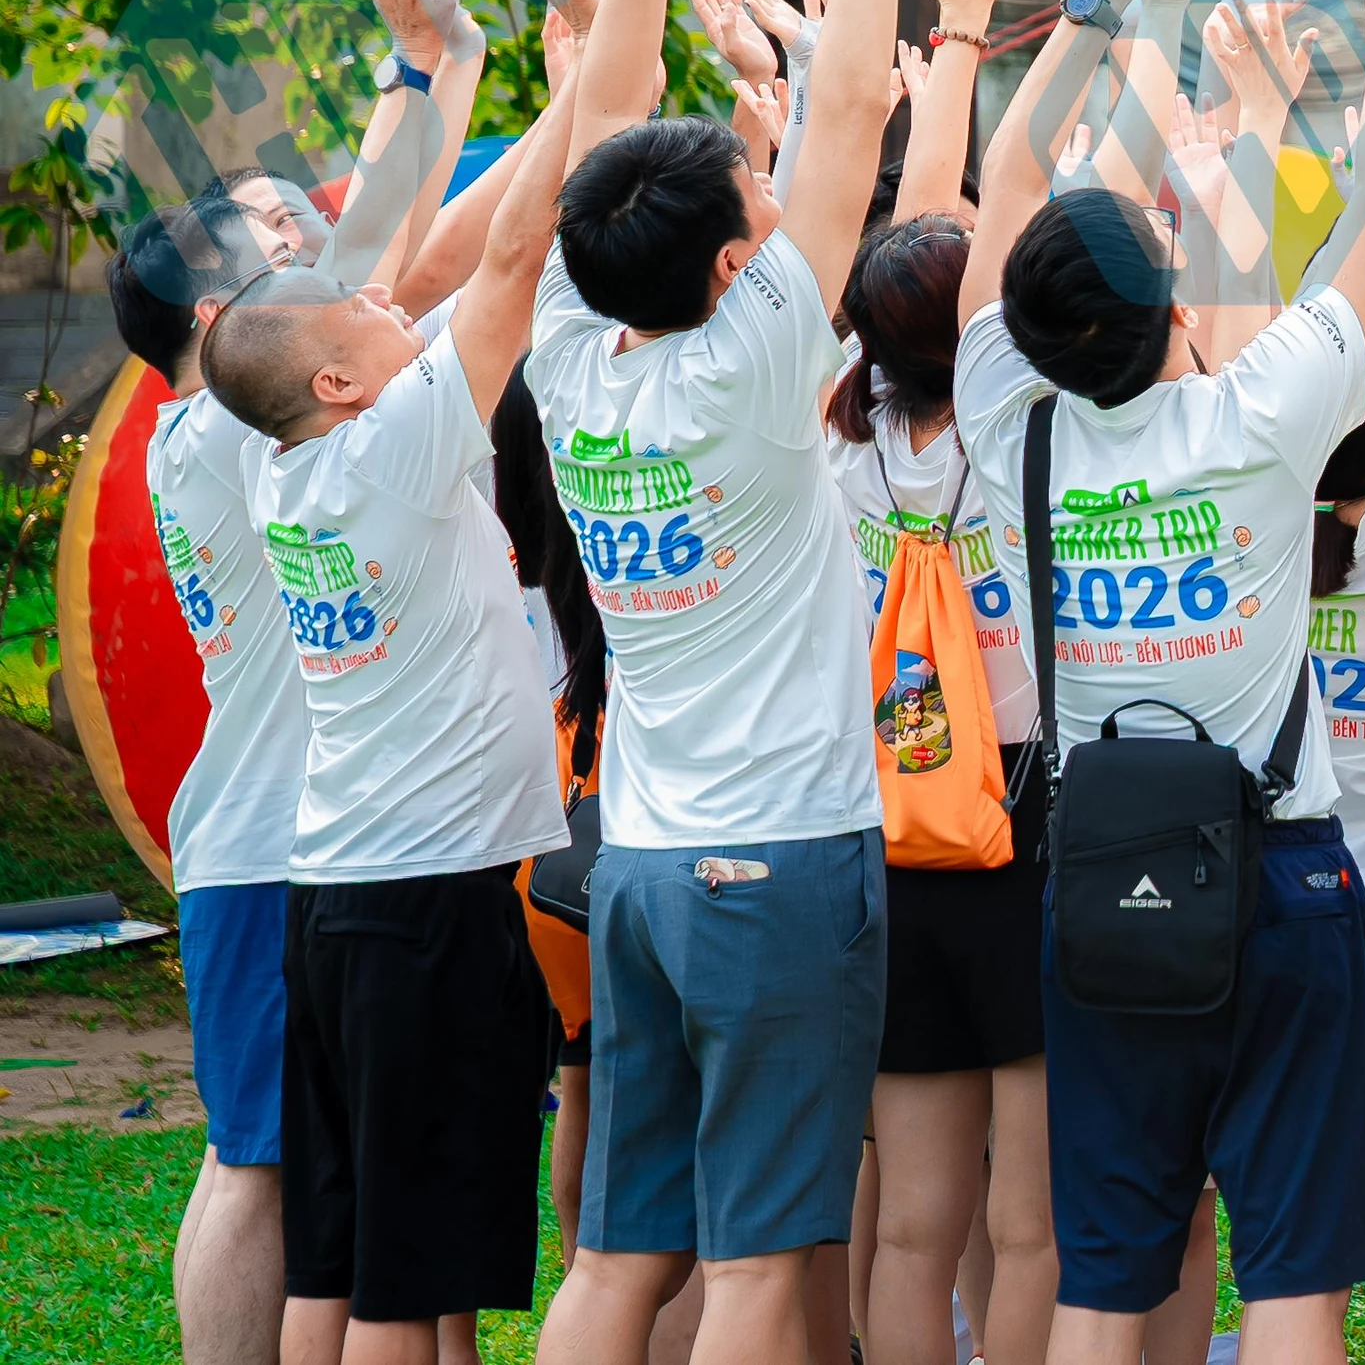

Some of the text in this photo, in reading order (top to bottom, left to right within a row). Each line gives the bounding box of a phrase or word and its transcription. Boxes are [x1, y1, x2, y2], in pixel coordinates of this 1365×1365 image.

[637, 460, 693, 513] TRIP
[950, 525, 995, 577] TRI
[1152, 500, 1222, 557] TRIP
[316, 542, 359, 593] TRIP
[1052, 556, 1229, 630] 2026
[1007, 625, 1019, 645] LA
[1072, 640, 1094, 666] NỘI
[1099, 640, 1123, 666] LỰC
[1136, 635, 1162, 662] BỀN
[1165, 633, 1216, 661] TƯƠNG
[1220, 626, 1245, 651] LAI
[1333, 716, 1358, 739] BỀN
[1119, 898, 1172, 908] EIGER
